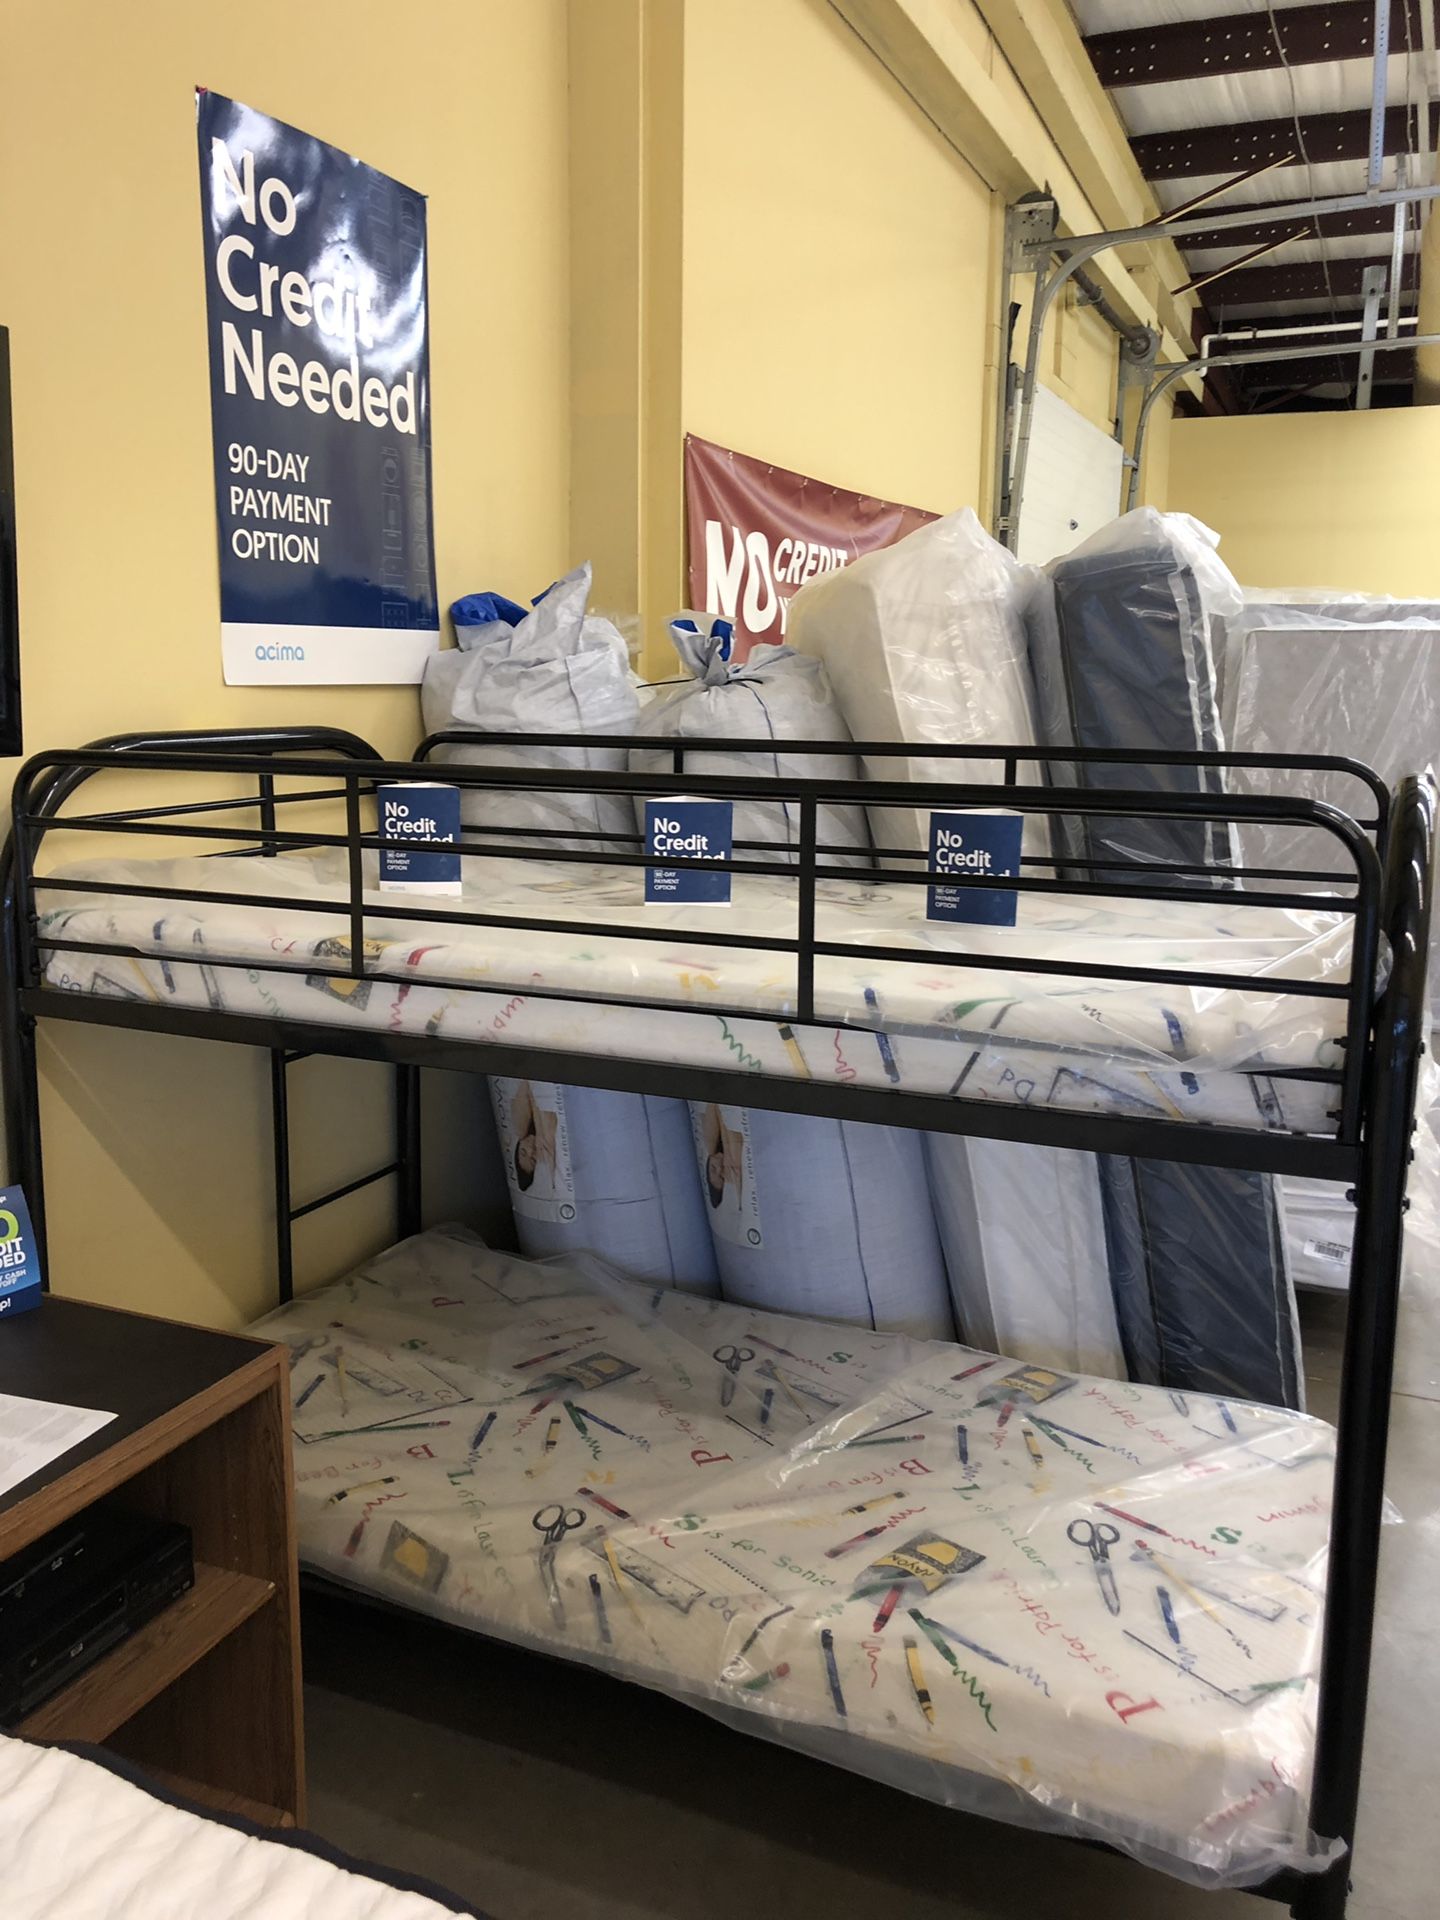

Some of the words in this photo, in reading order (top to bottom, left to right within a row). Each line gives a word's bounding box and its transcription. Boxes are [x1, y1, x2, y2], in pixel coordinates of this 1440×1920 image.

[211, 137, 297, 236] No
[216, 234, 374, 349] Credit
[221, 320, 417, 435] Needed
[228, 442, 309, 483] 90-DAY
[230, 486, 331, 526] PAYMENT
[231, 528, 320, 565] OPTION
[705, 519, 778, 633] NO
[255, 642, 305, 661] acima
[385, 801, 409, 817] No
[385, 818, 437, 833] Credit
[654, 817, 681, 834] No
[936, 829, 963, 848] No
[653, 834, 708, 850] Credit
[935, 847, 992, 868] Credit
[1210, 1526, 1243, 1544] S
[1061, 1633, 1097, 1663] for
[1104, 1690, 1166, 1725] P
